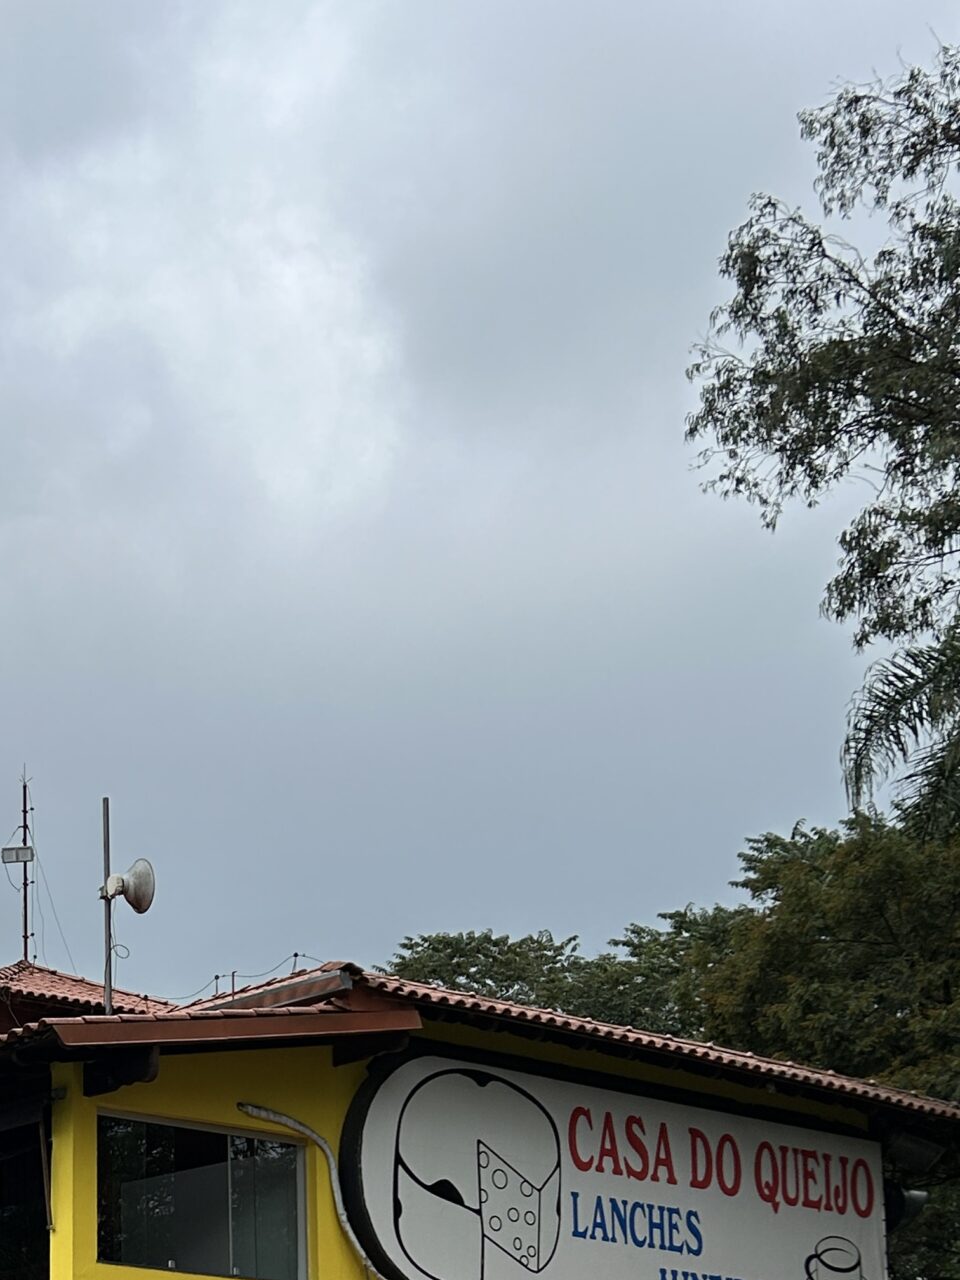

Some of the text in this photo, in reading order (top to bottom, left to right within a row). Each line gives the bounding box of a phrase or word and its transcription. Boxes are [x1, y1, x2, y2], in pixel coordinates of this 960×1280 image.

[568, 1106, 874, 1218] CASA DO QUEIJO
[570, 1191, 703, 1256] LANCHES
